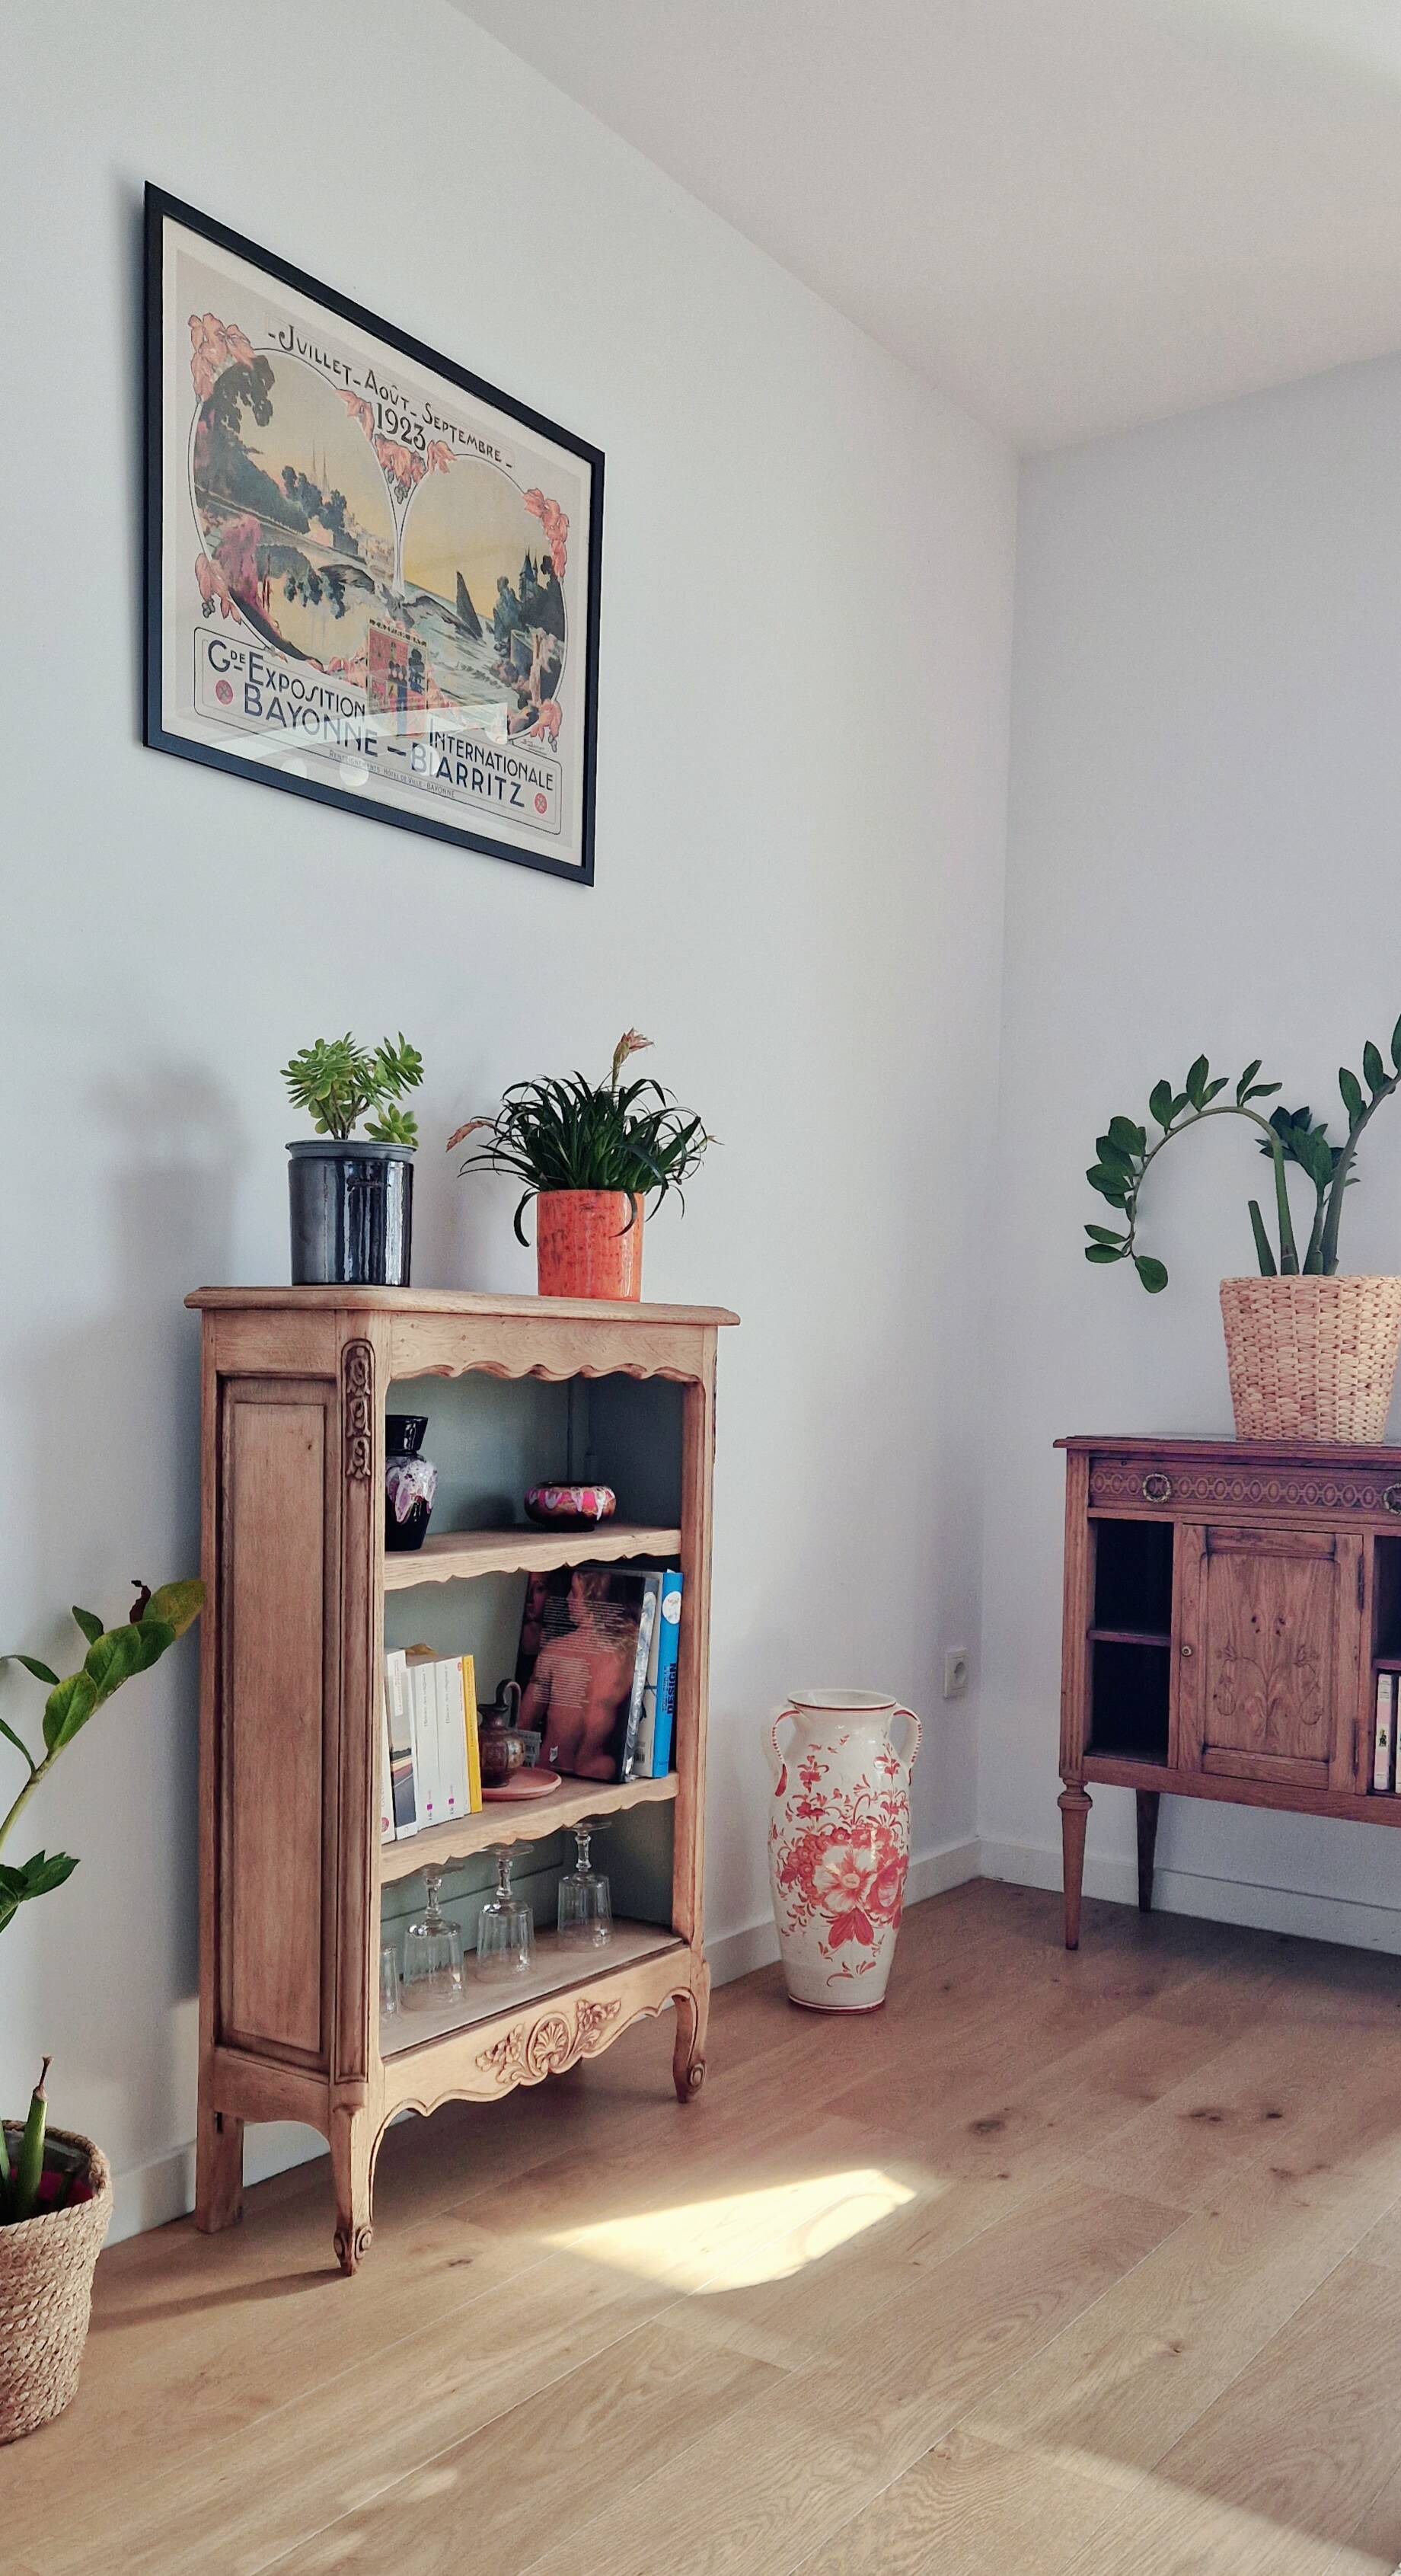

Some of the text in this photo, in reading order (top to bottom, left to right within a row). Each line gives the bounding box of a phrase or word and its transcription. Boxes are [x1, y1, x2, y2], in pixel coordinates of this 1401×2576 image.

[377, 402, 426, 451] 1923
[422, 402, 502, 462] SEPTEMBRE
[244, 682, 525, 808] BAYONNE BIARRITZ
[249, 651, 365, 721] EXPOSITION
[429, 718, 554, 791] INTERNATIONALE
[426, 781, 455, 798] BAYONNE
[666, 1663, 677, 1715] DESIGN
